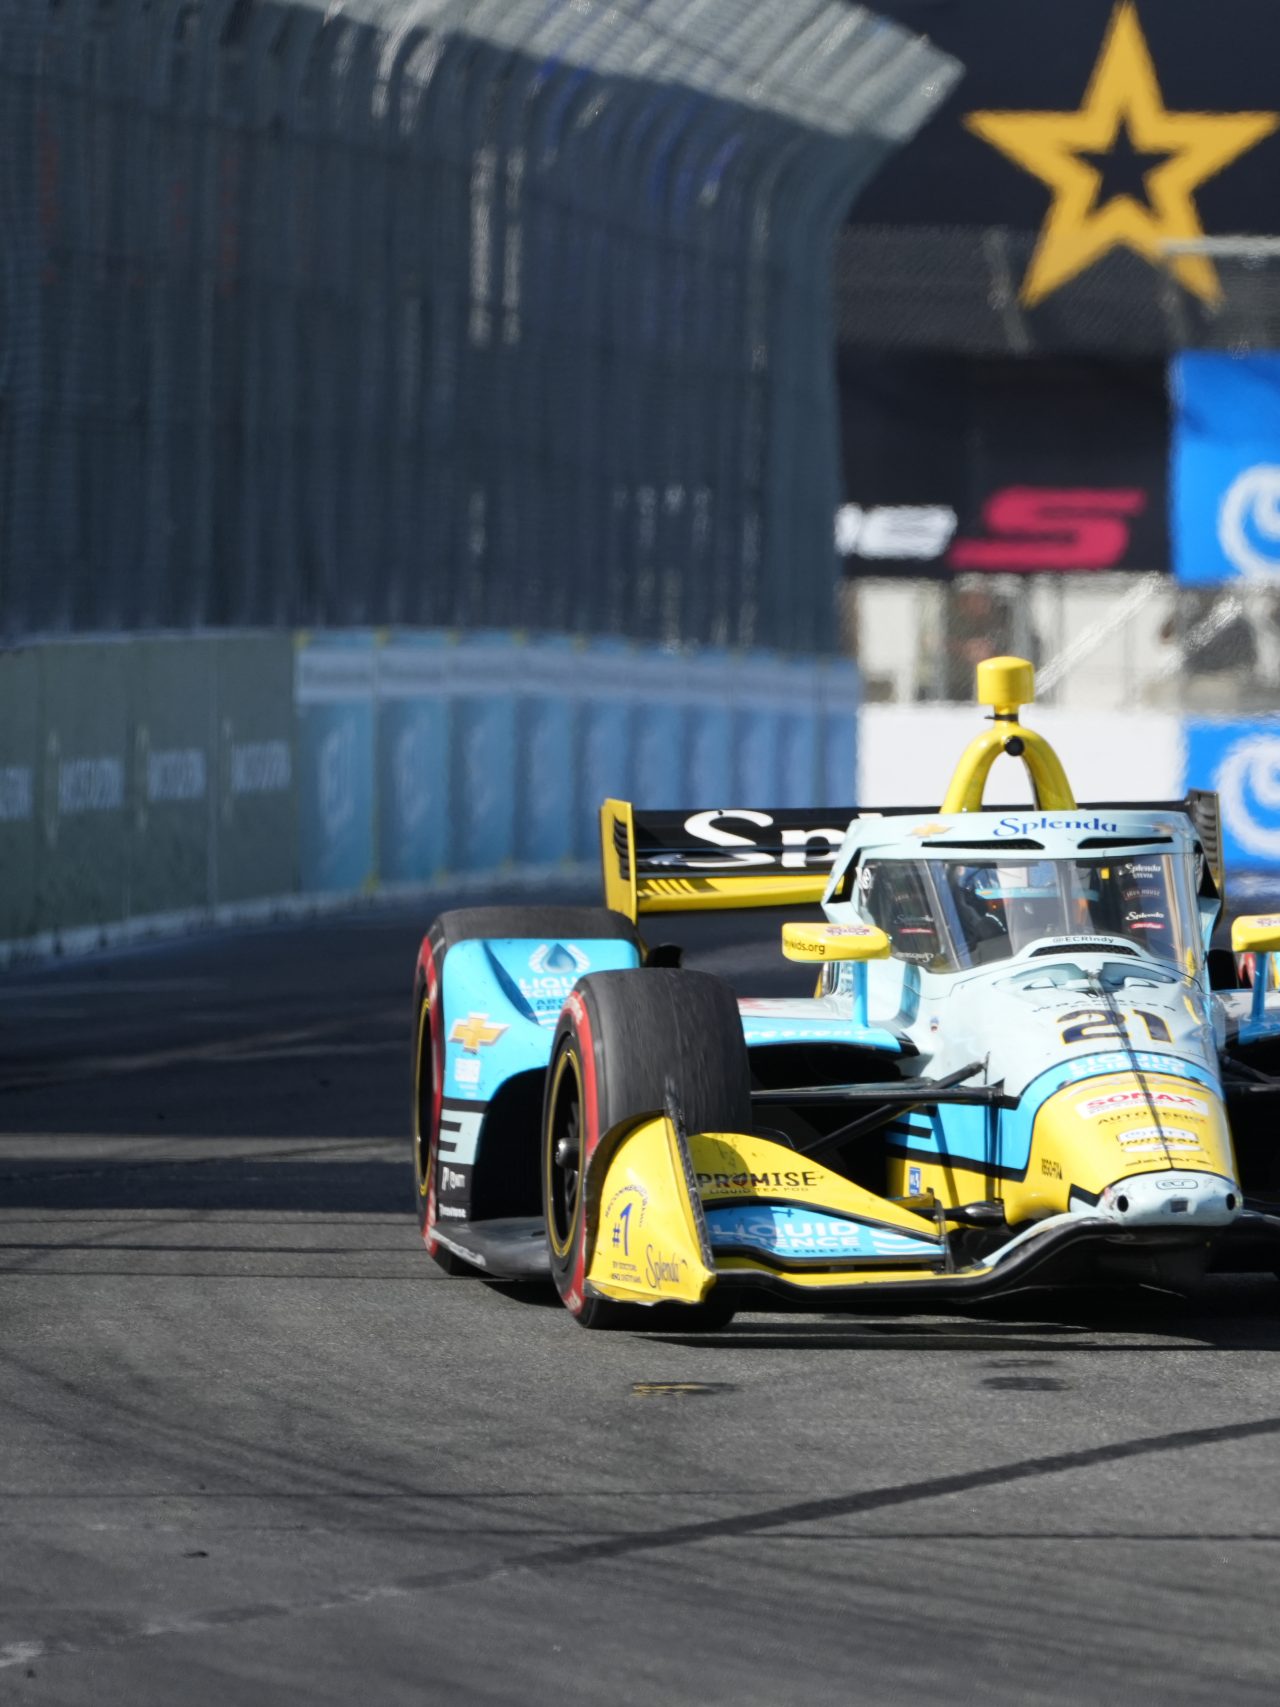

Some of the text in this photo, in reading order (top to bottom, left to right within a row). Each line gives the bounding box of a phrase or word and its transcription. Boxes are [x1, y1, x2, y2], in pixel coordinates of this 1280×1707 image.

[993, 817, 1118, 837] Splenda
[650, 808, 883, 868] Sp
[1119, 863, 1162, 877] Splenda
[1125, 911, 1165, 921] Splenda
[518, 976, 577, 989] LIQU
[521, 988, 573, 998] SCIE
[1057, 1008, 1175, 1045] 21
[1086, 1092, 1197, 1109] SONAX
[697, 1171, 819, 1188] PROMISE
[712, 1221, 861, 1239] LIQUID
[645, 1243, 681, 1290] Splenda
